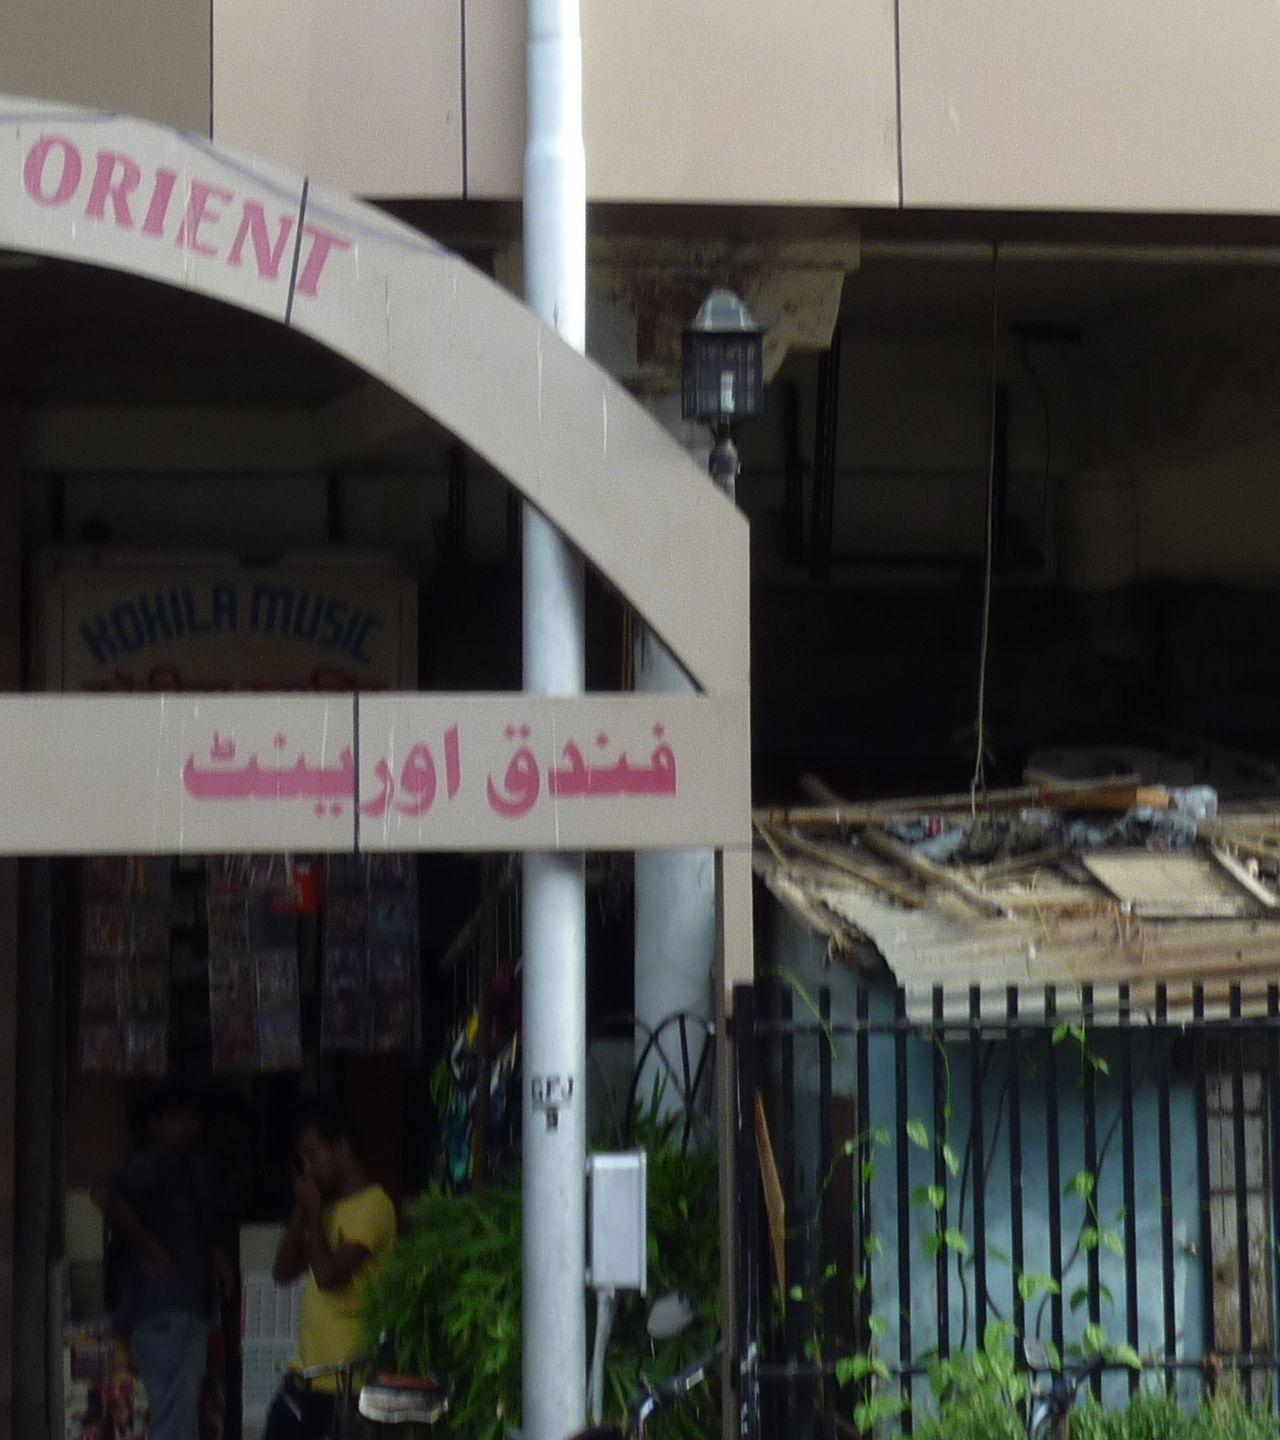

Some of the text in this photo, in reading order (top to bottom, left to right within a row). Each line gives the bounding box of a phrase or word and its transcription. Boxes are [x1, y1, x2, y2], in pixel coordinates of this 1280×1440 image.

[22, 133, 350, 298] ORIENT
[251, 582, 385, 667] MUSIC
[486, 723, 677, 820] فندق
